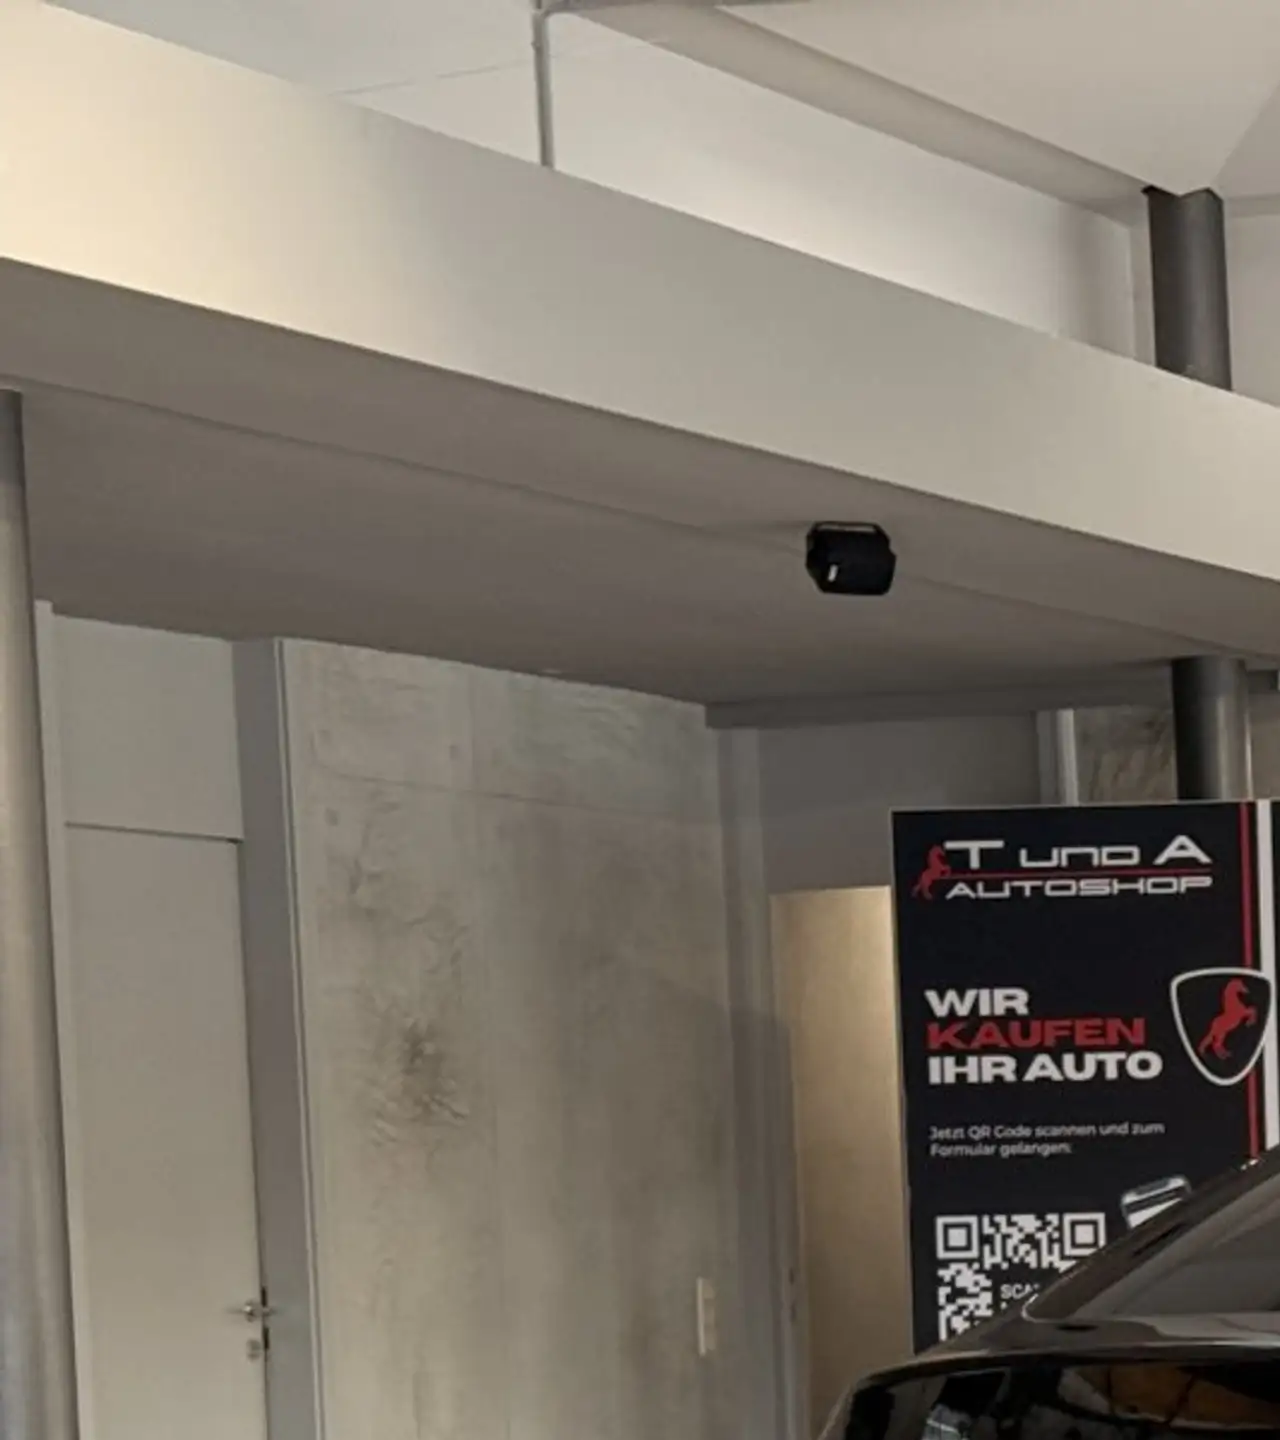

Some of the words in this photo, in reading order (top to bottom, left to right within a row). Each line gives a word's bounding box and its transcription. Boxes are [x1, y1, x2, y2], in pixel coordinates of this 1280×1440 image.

[943, 839, 1005, 870] T
[1152, 834, 1213, 866] A
[946, 876, 1213, 900] AUTOSHOP
[923, 986, 1030, 1018] WIR
[926, 1017, 1146, 1050] KAUFEN
[928, 1055, 1018, 1085] IHR
[1021, 1050, 1164, 1082] AUTO
[928, 1125, 966, 1140] Jetzt
[967, 1125, 992, 1142] QR
[993, 1122, 1032, 1140] Code
[1034, 1121, 1097, 1139] scannen
[1099, 1120, 1130, 1136] und
[1131, 1122, 1166, 1136] zum
[929, 1141, 997, 1157] Formular
